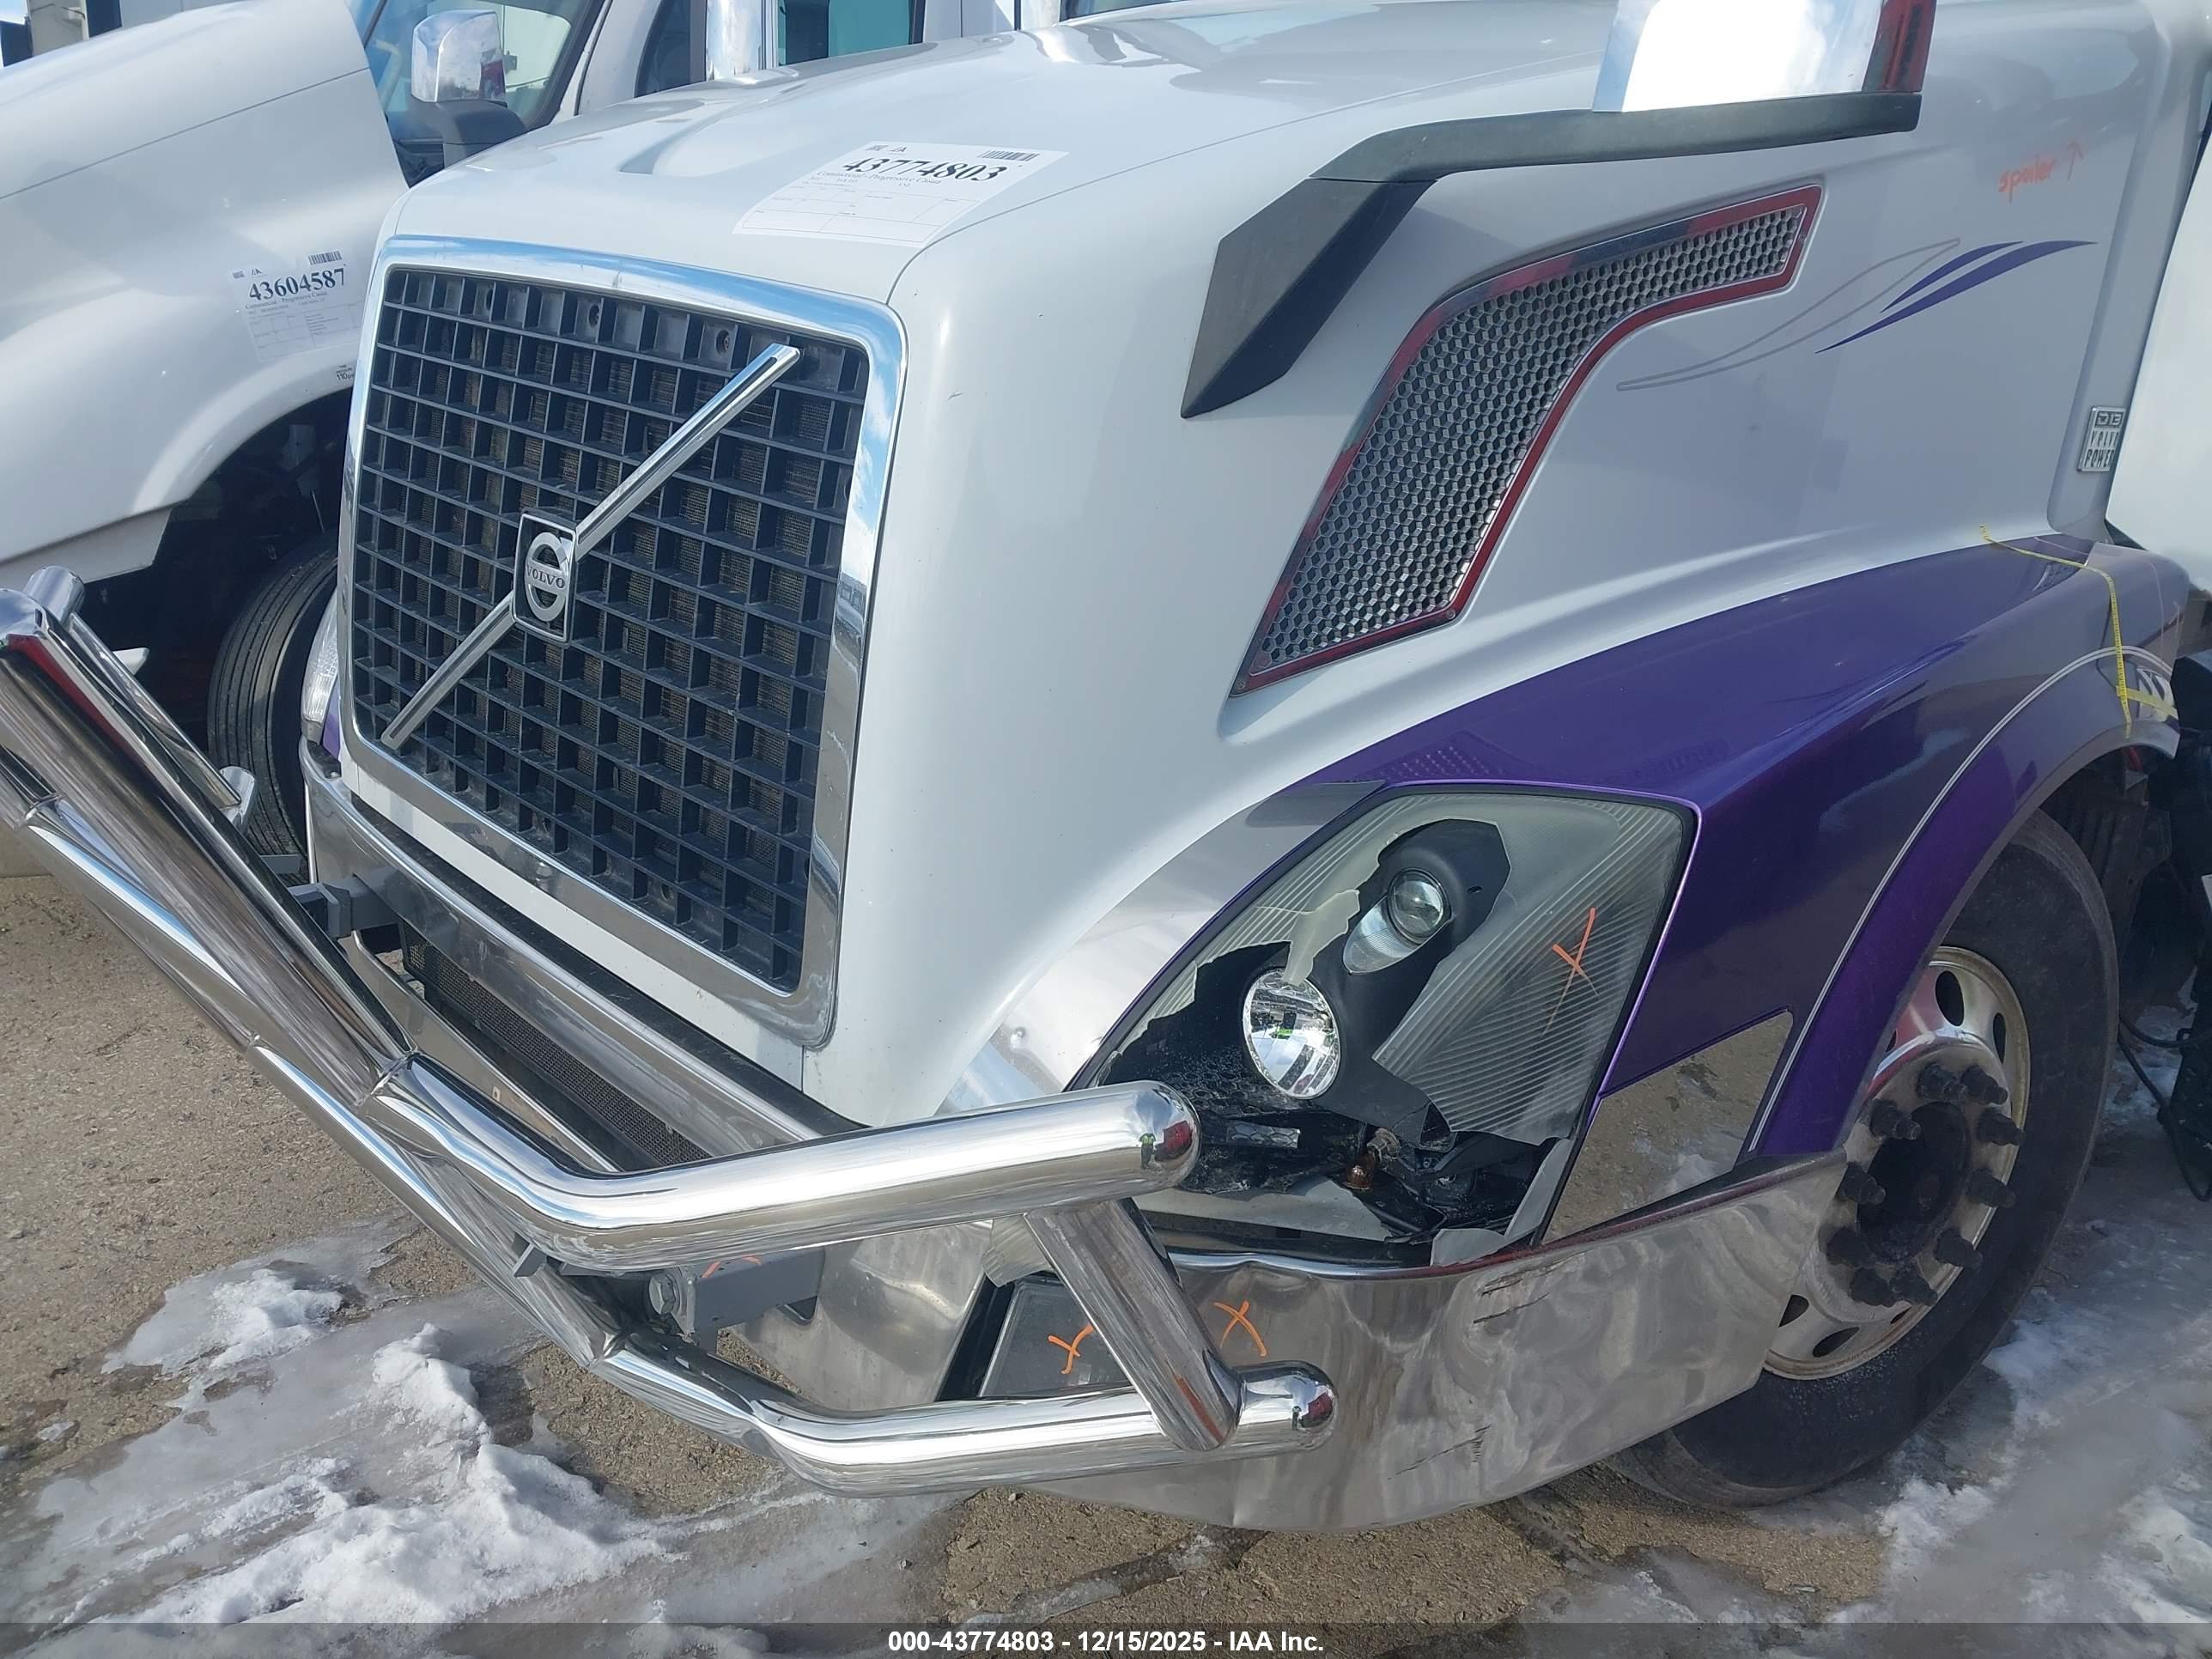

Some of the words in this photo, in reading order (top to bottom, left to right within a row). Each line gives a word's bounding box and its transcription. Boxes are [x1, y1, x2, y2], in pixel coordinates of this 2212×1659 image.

[842, 157, 1007, 181] 43774803
[248, 267, 345, 301] 43604587
[526, 563, 566, 589] VOLVO
